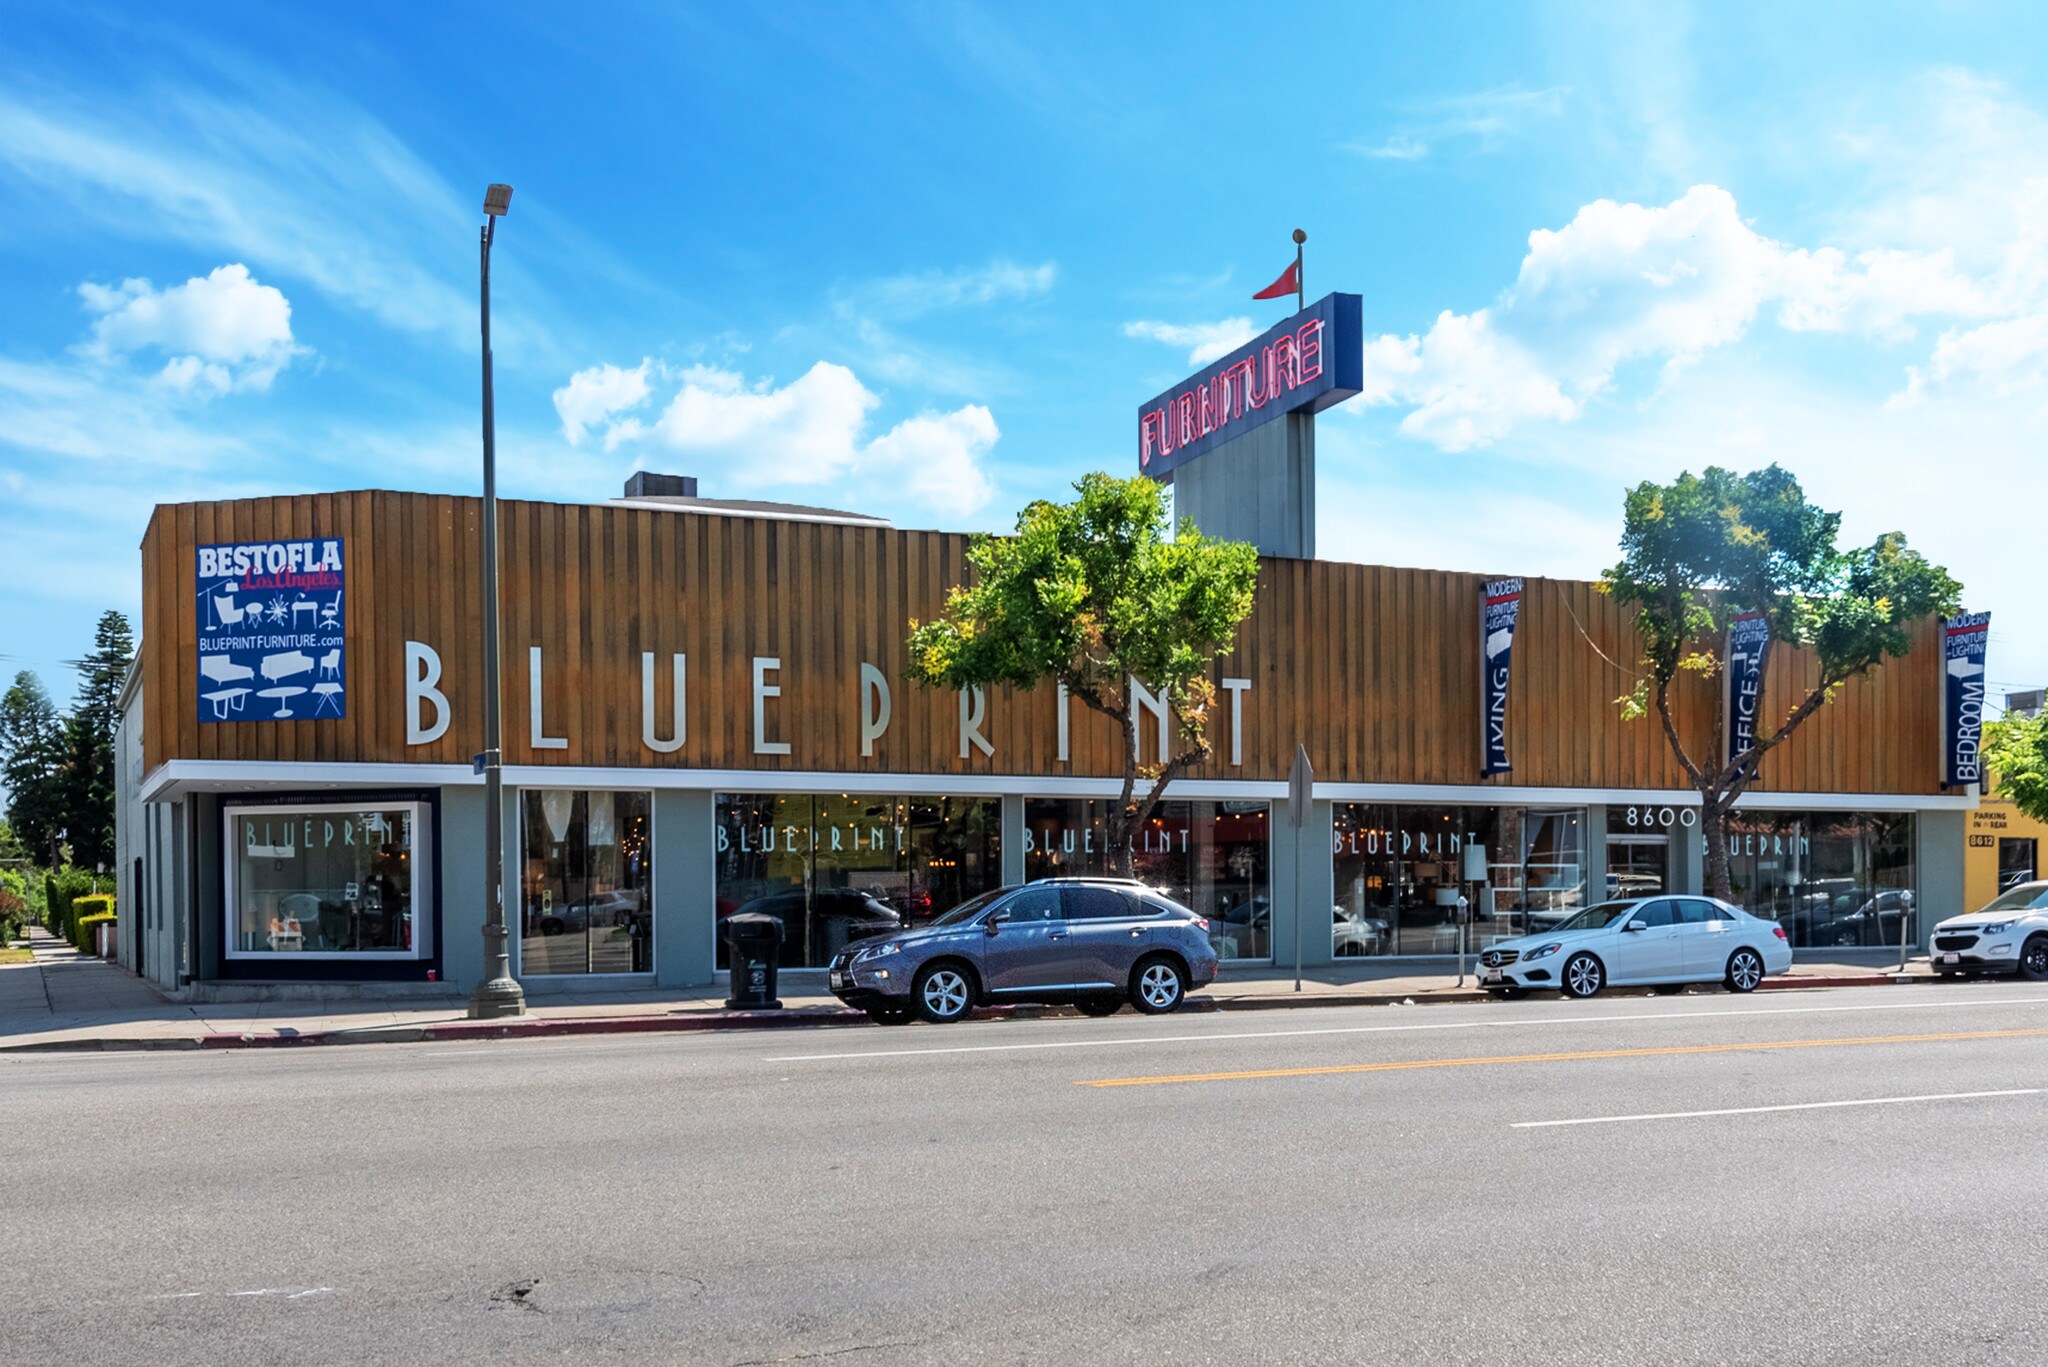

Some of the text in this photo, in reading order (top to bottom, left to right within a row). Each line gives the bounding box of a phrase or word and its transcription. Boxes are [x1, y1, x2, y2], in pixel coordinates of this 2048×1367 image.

[1141, 319, 1321, 467] FURNITURE
[240, 562, 342, 592] Los Angeles
[1487, 578, 1522, 598] MODERN
[1947, 613, 1989, 629] MODERN
[1491, 668, 1511, 767] LIVING
[1737, 679, 1758, 775] FFICE
[1956, 682, 1984, 780] BEDROOM
[1627, 807, 1696, 826] 8600
[1974, 812, 2006, 820] PARKING
[1990, 821, 2007, 829] REAR
[1025, 828, 1189, 853] BLUEINT
[1334, 831, 1476, 855] BLUEPRINT
[1970, 835, 1993, 846] 8612
